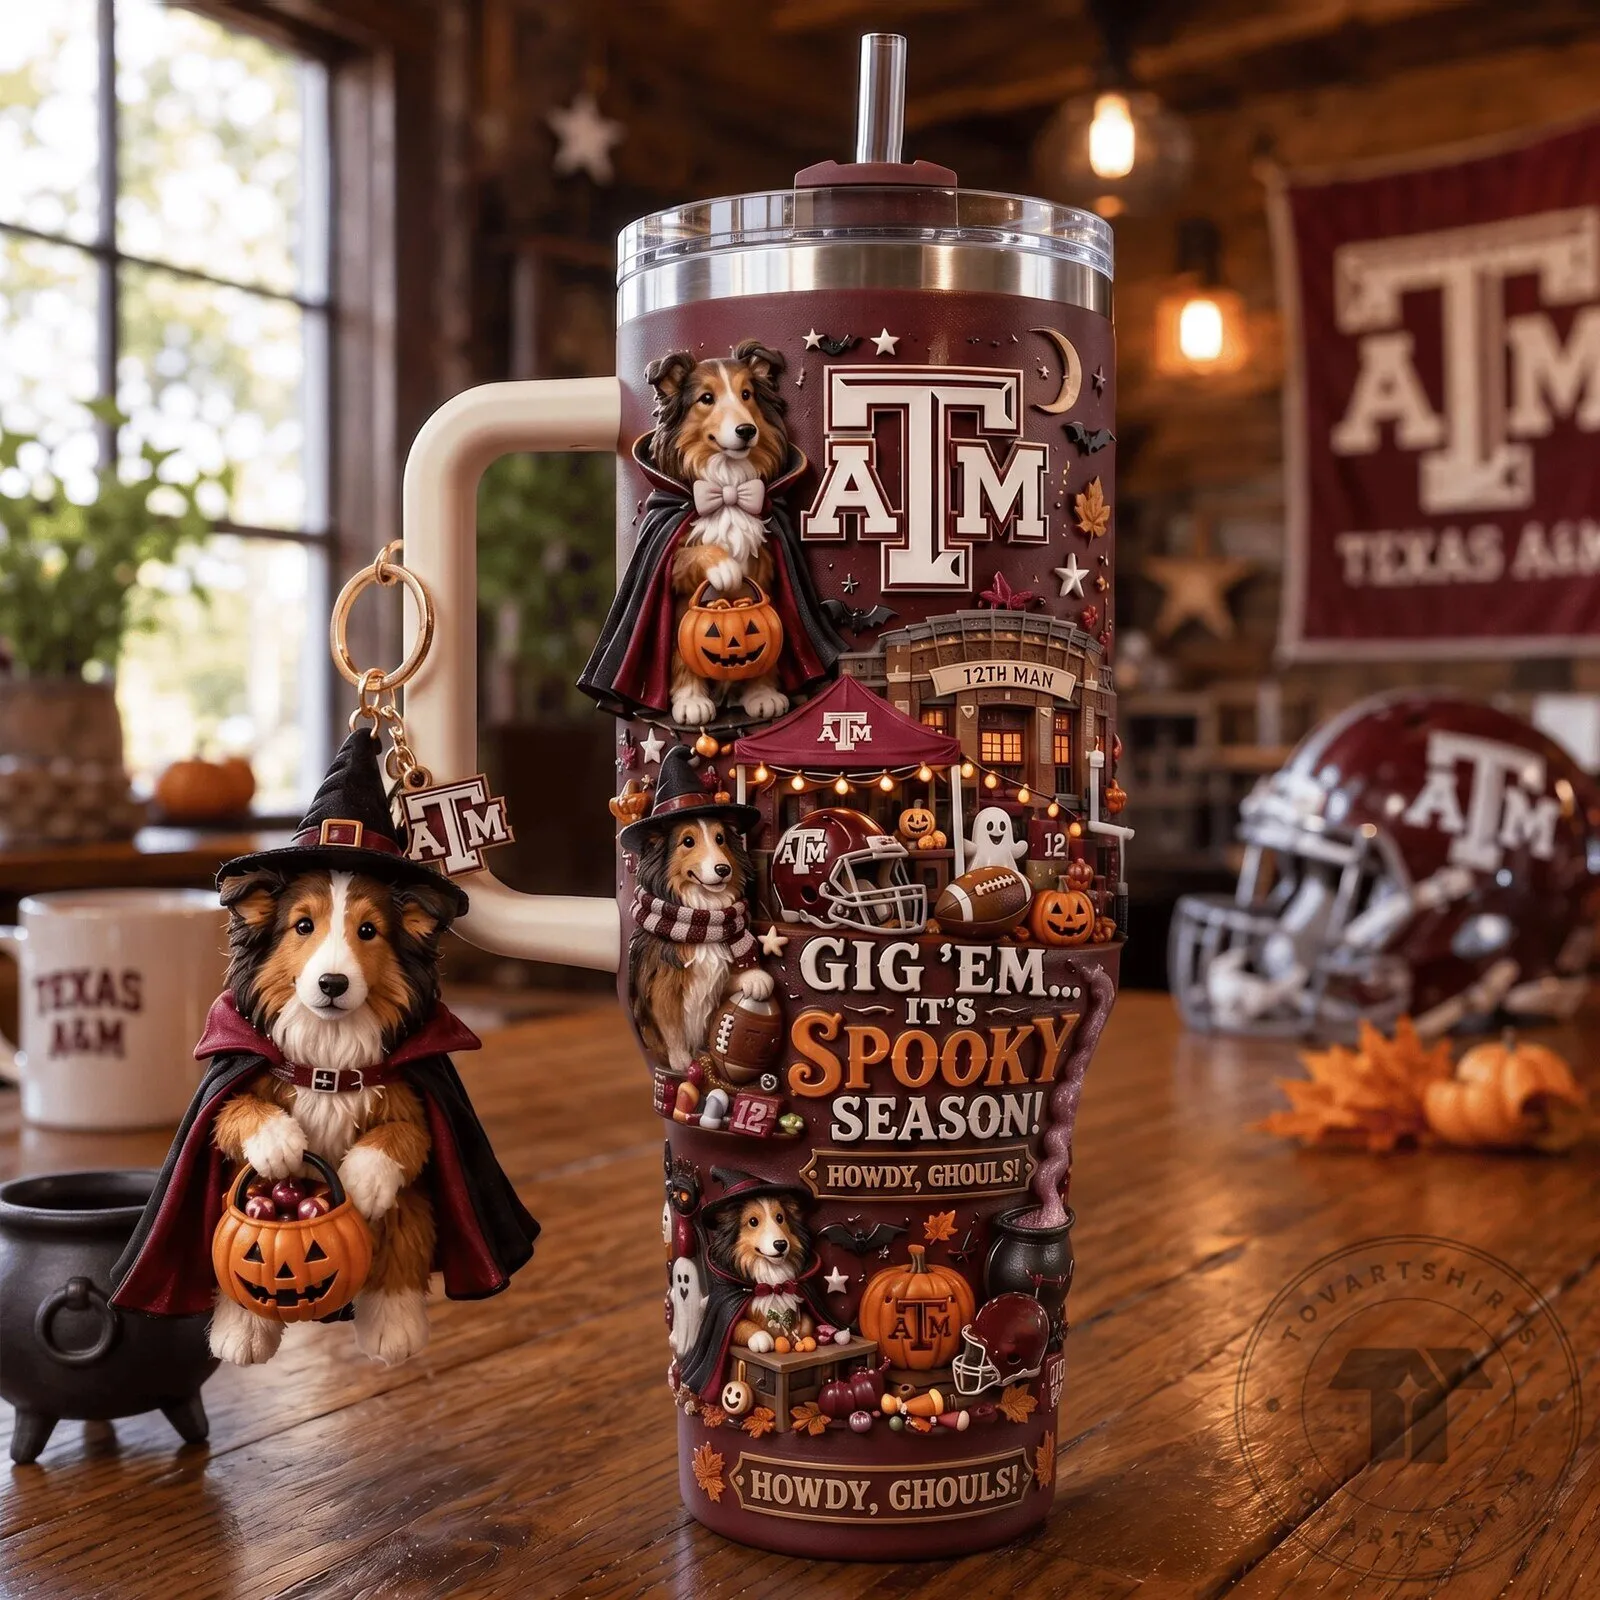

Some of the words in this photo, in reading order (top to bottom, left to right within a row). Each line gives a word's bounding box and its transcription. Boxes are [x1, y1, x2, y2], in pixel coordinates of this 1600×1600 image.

[1335, 524, 1504, 588] TEXAS
[963, 666, 1007, 685] 12TH
[1013, 666, 1054, 689] MAN
[1044, 832, 1066, 857] 12
[799, 936, 925, 993] GIG
[35, 967, 143, 1015] TEXAS
[906, 997, 976, 1026] IT'S
[49, 1017, 126, 1060] A&M
[788, 1010, 1081, 1097] SPOOKY
[733, 1099, 769, 1133] 12
[831, 1091, 1043, 1142] SEASON!
[826, 1163, 922, 1193] HOWDY,
[928, 1159, 1020, 1187] GHOULS!
[750, 1468, 880, 1516] HOWDY,
[889, 1464, 1019, 1512] GHOULS!
